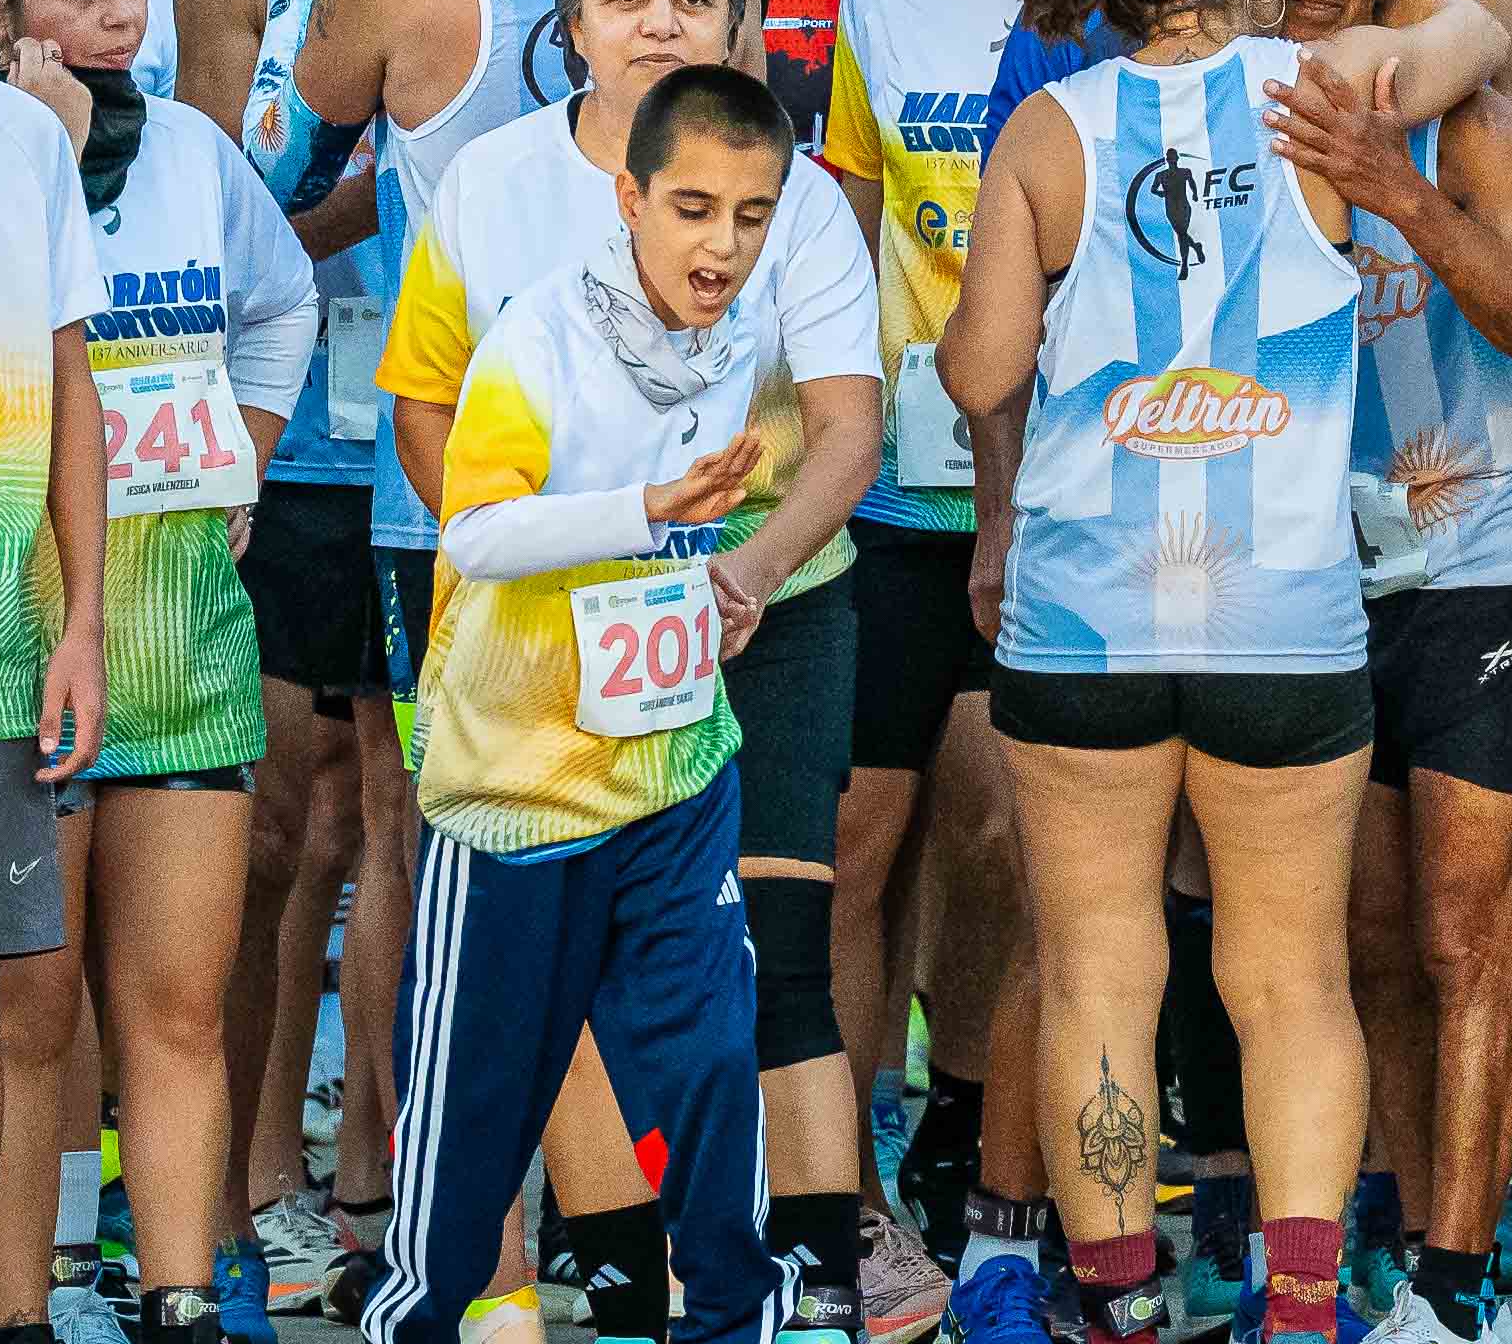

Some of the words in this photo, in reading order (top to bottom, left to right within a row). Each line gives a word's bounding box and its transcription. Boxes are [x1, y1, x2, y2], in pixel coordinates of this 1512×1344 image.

[898, 92, 988, 124] MAR
[1202, 163, 1256, 199] FC
[1203, 193, 1249, 211] TEAM
[104, 260, 223, 308] RATÓN
[92, 344, 116, 363] 137
[118, 339, 211, 361] ANIVERSARIO
[104, 399, 236, 480] 241
[599, 604, 715, 699] 201
